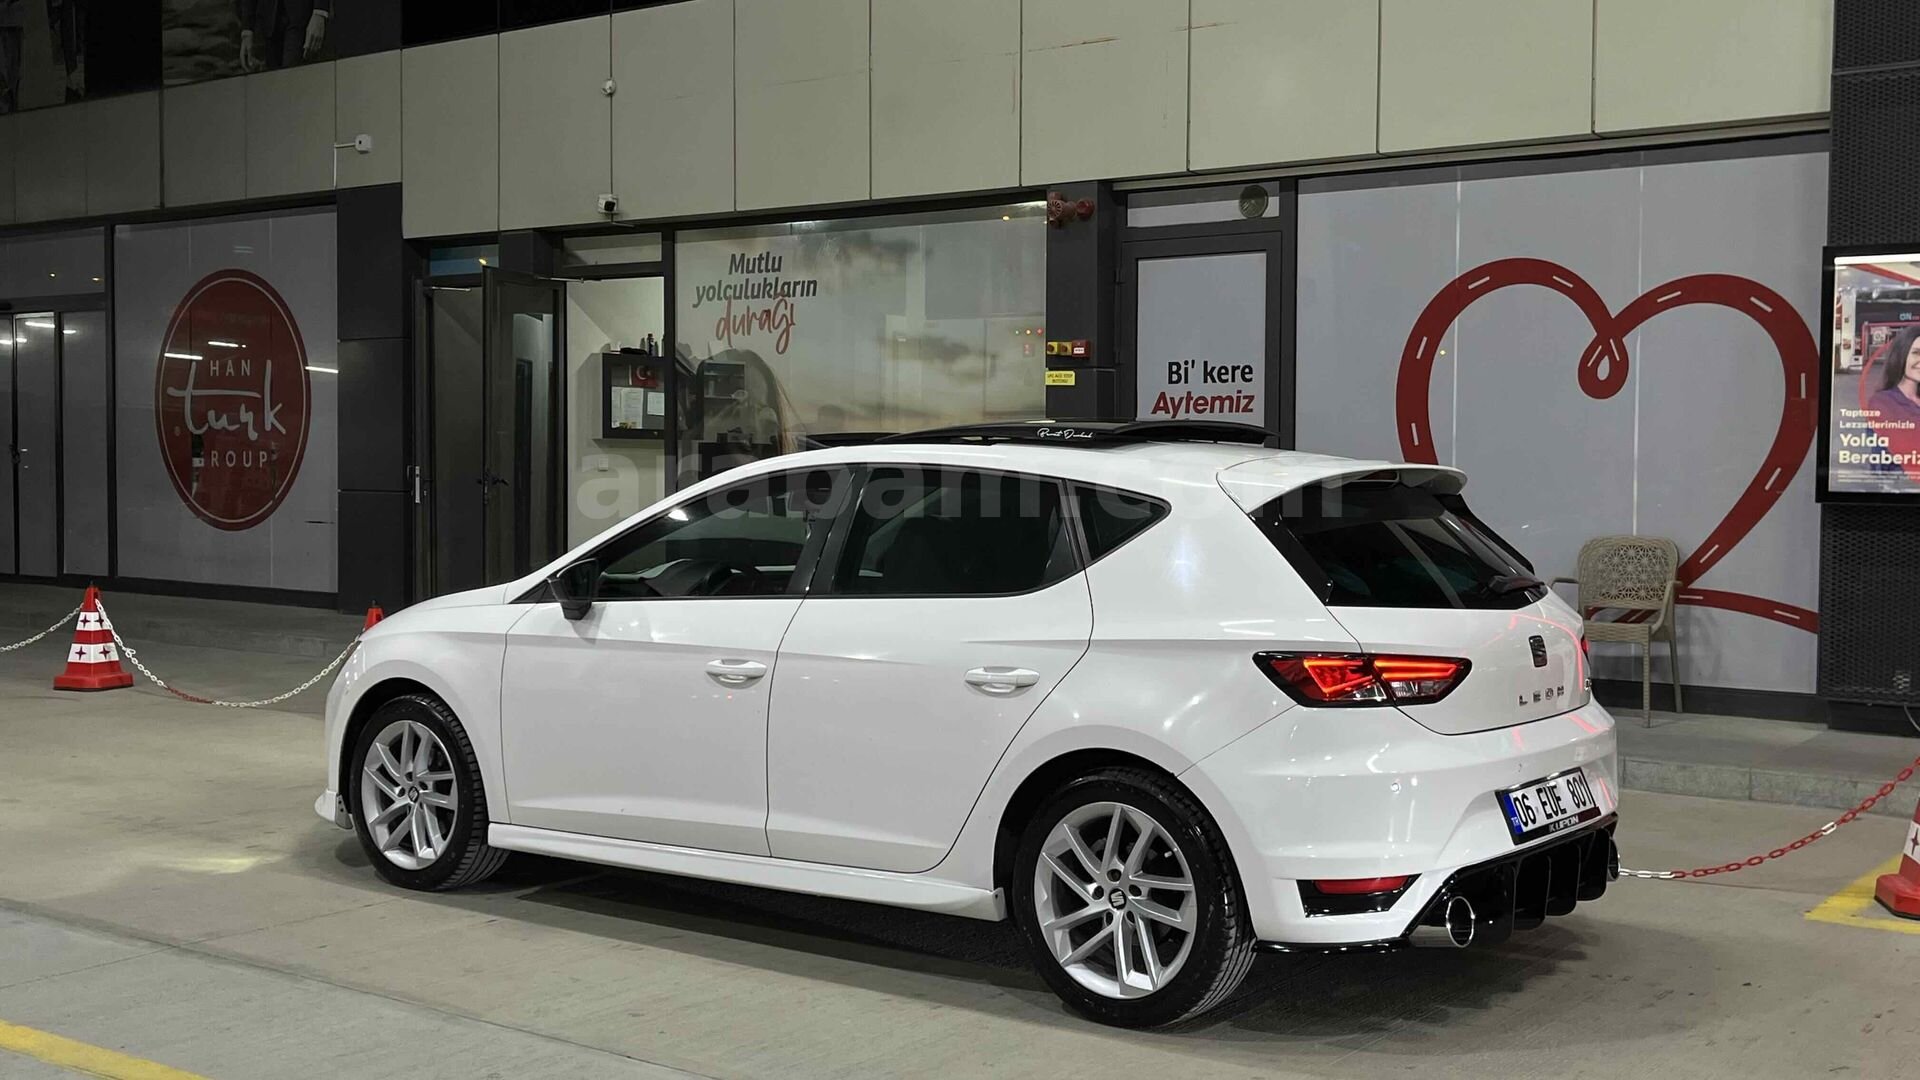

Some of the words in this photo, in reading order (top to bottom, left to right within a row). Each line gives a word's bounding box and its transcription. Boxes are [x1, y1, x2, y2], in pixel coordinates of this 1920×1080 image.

[728, 251, 783, 275] Mutlu
[692, 276, 818, 309] yolculukların
[210, 359, 251, 377] HAN
[1167, 359, 1196, 385] Bi'
[1203, 360, 1254, 384] kere
[1151, 389, 1255, 419] Aytemiz
[1840, 408, 1881, 418] Taptaze
[1839, 420, 1916, 430] Lezzetlerimizle
[1840, 433, 1889, 448] Yolda
[1513, 792, 1537, 827] 06
[1536, 785, 1567, 820] EUE
[1566, 774, 1592, 809] 801
